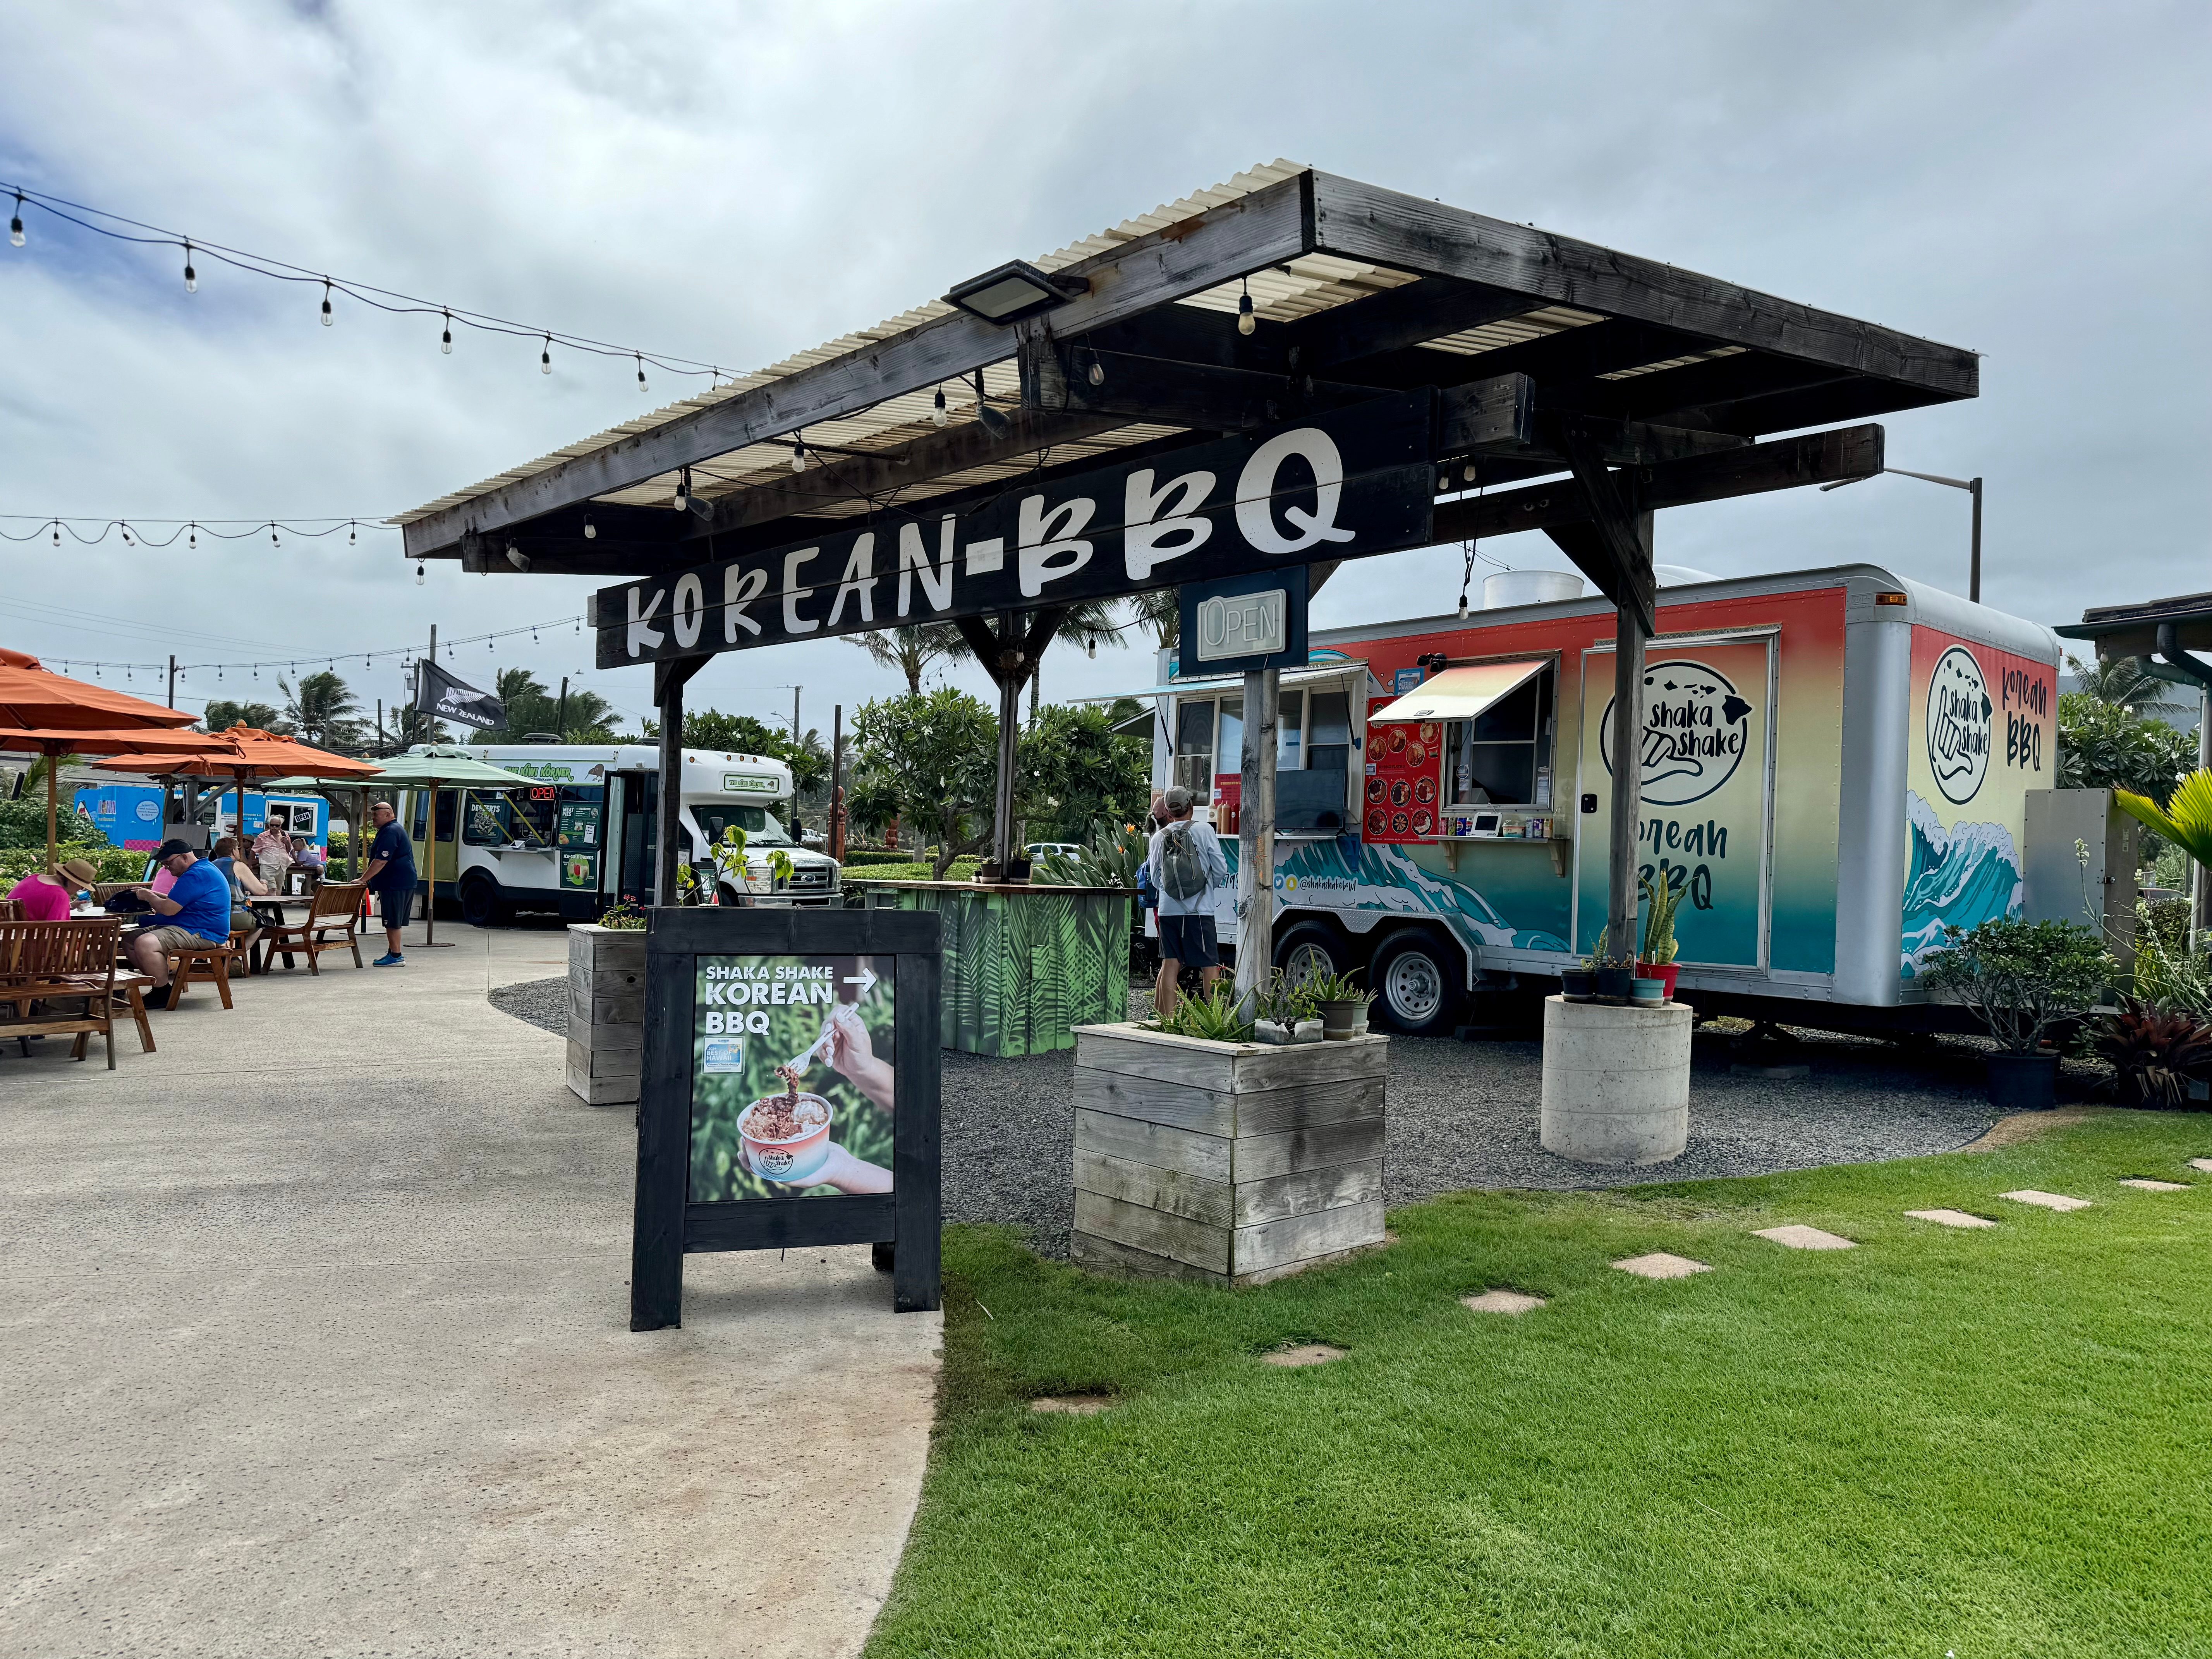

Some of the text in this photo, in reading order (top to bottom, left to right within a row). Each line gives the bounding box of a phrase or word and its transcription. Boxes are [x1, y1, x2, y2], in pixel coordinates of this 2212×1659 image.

[627, 427, 1356, 657] KOREAN-BBQ
[1204, 599, 1276, 646] OPEN
[436, 703, 495, 726] NEW ZEALAND
[1649, 699, 1713, 729] shaka
[1949, 690, 1977, 721] shaka
[1677, 728, 1739, 757] shake
[1962, 725, 1988, 756] shake
[2007, 711, 2040, 772] BBQ
[520, 763, 539, 777] KIWI
[539, 763, 574, 782] KORNER
[749, 779, 765, 788] KORNER
[295, 813, 310, 822] OPEN
[1639, 819, 1728, 859] rean
[1300, 879, 1356, 891] @shakashakebowl
[706, 966, 833, 980] SHAKA SHAKE
[705, 982, 833, 1005] KOREAN
[706, 1010, 769, 1036] BBQ
